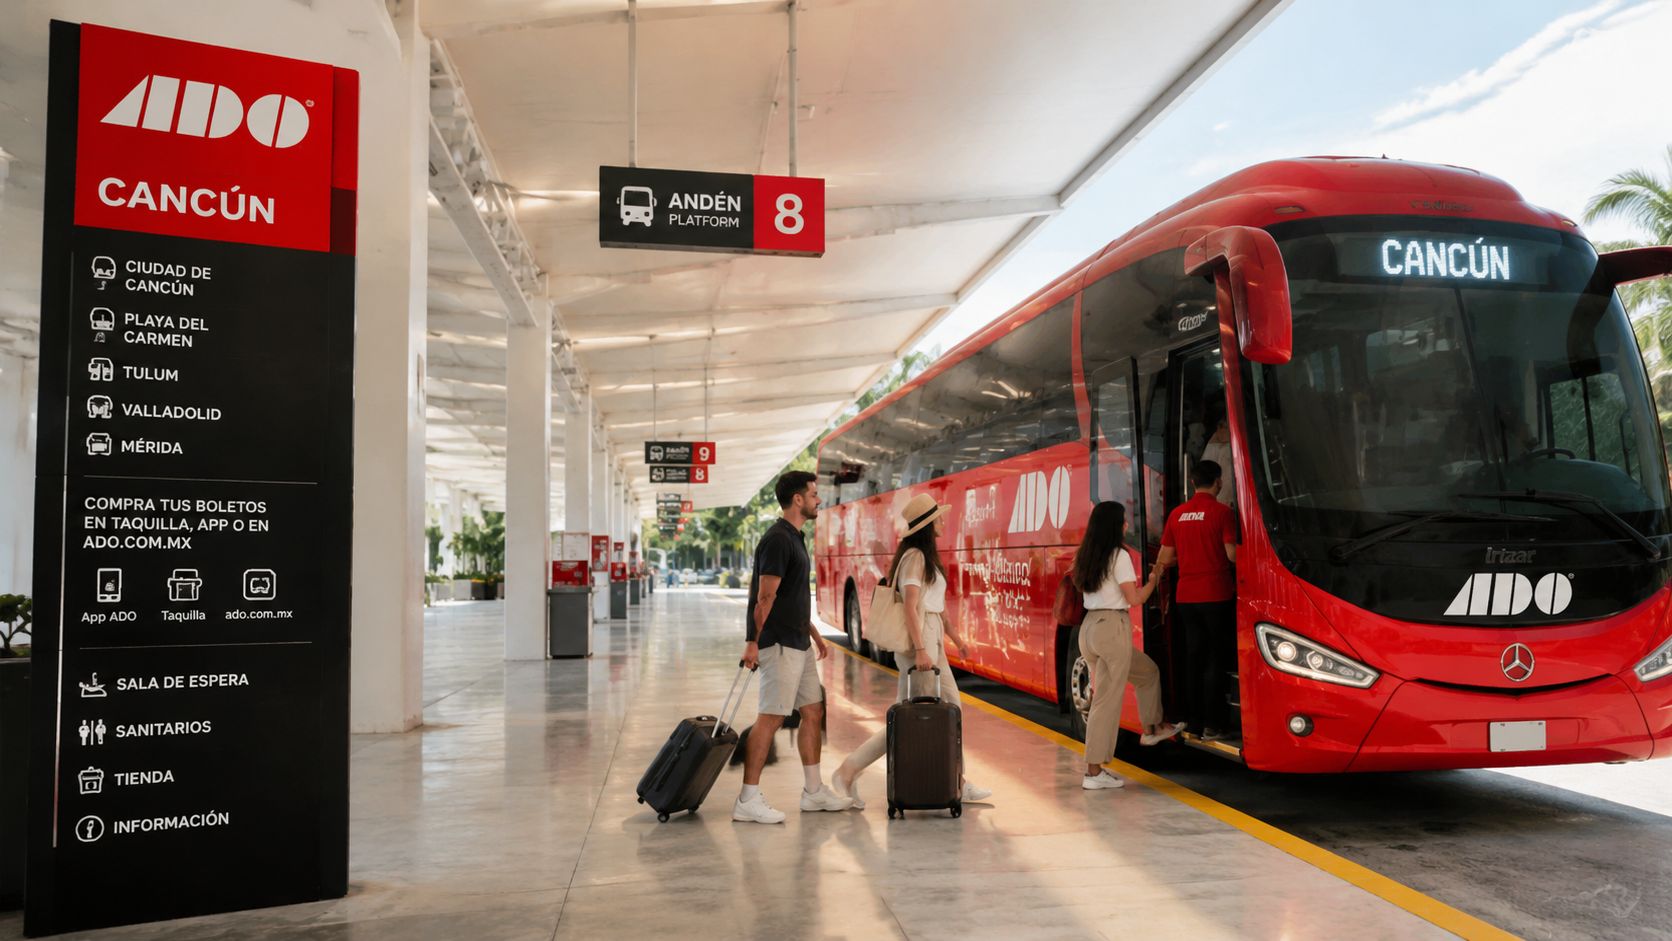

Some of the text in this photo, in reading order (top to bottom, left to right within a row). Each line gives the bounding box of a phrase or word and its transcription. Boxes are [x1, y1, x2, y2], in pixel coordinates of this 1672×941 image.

[98, 177, 275, 225] CANCÚN
[668, 191, 741, 212] ANDÉN
[669, 213, 740, 228] PLATFORM
[774, 193, 805, 235] 8
[1381, 237, 1511, 281] CANCÚN
[125, 260, 212, 280] CIUDAD DE
[125, 279, 194, 297] CANCÚN
[124, 313, 209, 331] PLAYA DEL
[124, 331, 193, 348] CARMEN
[122, 365, 179, 382] TULUM
[121, 403, 222, 421] VALLADOLID
[121, 438, 183, 455] MÉRIDA
[699, 446, 710, 462] 9
[84, 496, 267, 513] COMPRA TUS BOLETOS
[84, 516, 269, 532] EN TAQUILLA, APP O EN
[83, 535, 192, 550] ADO.COM.MX
[81, 611, 137, 625] App ADO
[161, 610, 206, 623] Taquilla
[225, 609, 293, 620] ado.com.mx
[116, 673, 249, 691] SALA DE ESPERA
[115, 720, 212, 738] SANITARIOS
[114, 770, 174, 786] TIENDA
[113, 810, 229, 834] INFORMACIÓN
